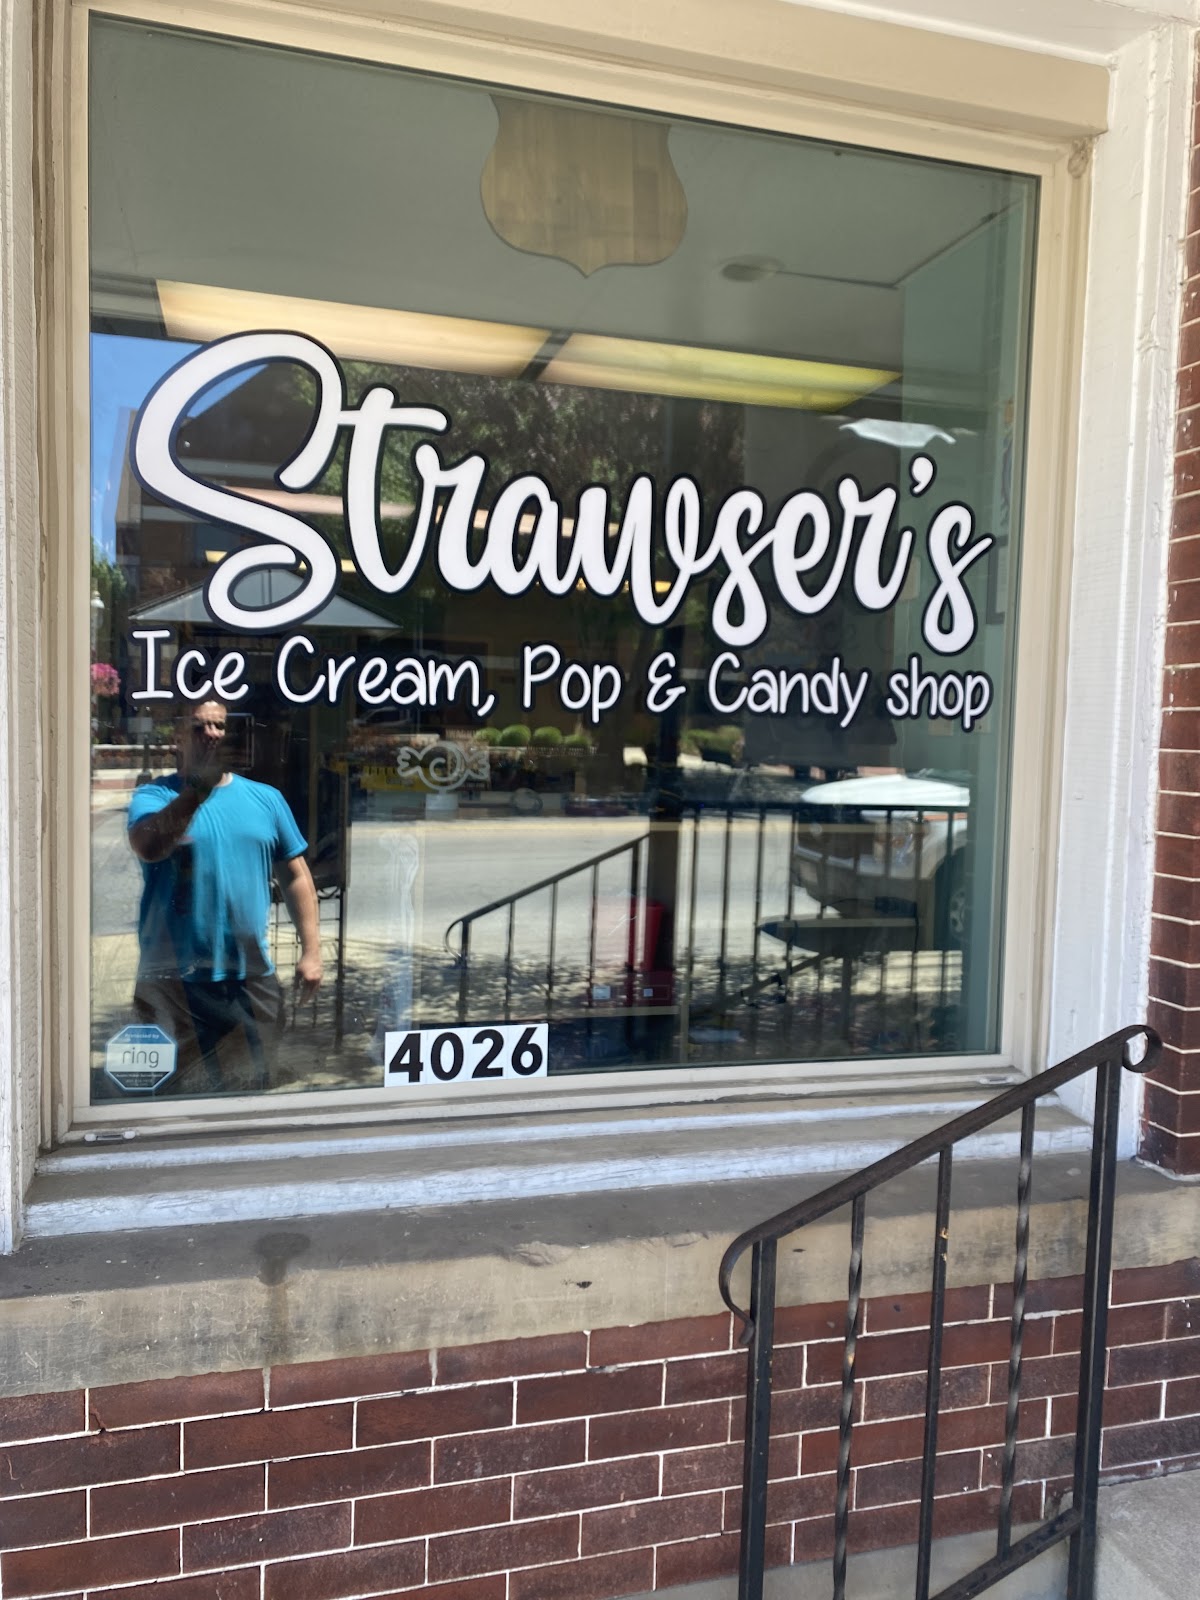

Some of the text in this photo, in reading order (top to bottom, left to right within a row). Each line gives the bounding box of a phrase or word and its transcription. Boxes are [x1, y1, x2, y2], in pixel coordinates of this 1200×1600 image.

[133, 332, 994, 653] Strawser's
[130, 629, 991, 729] Ice Cream, Pop & Candy shop
[122, 1047, 159, 1068] ring
[388, 1026, 543, 1083] 4026
